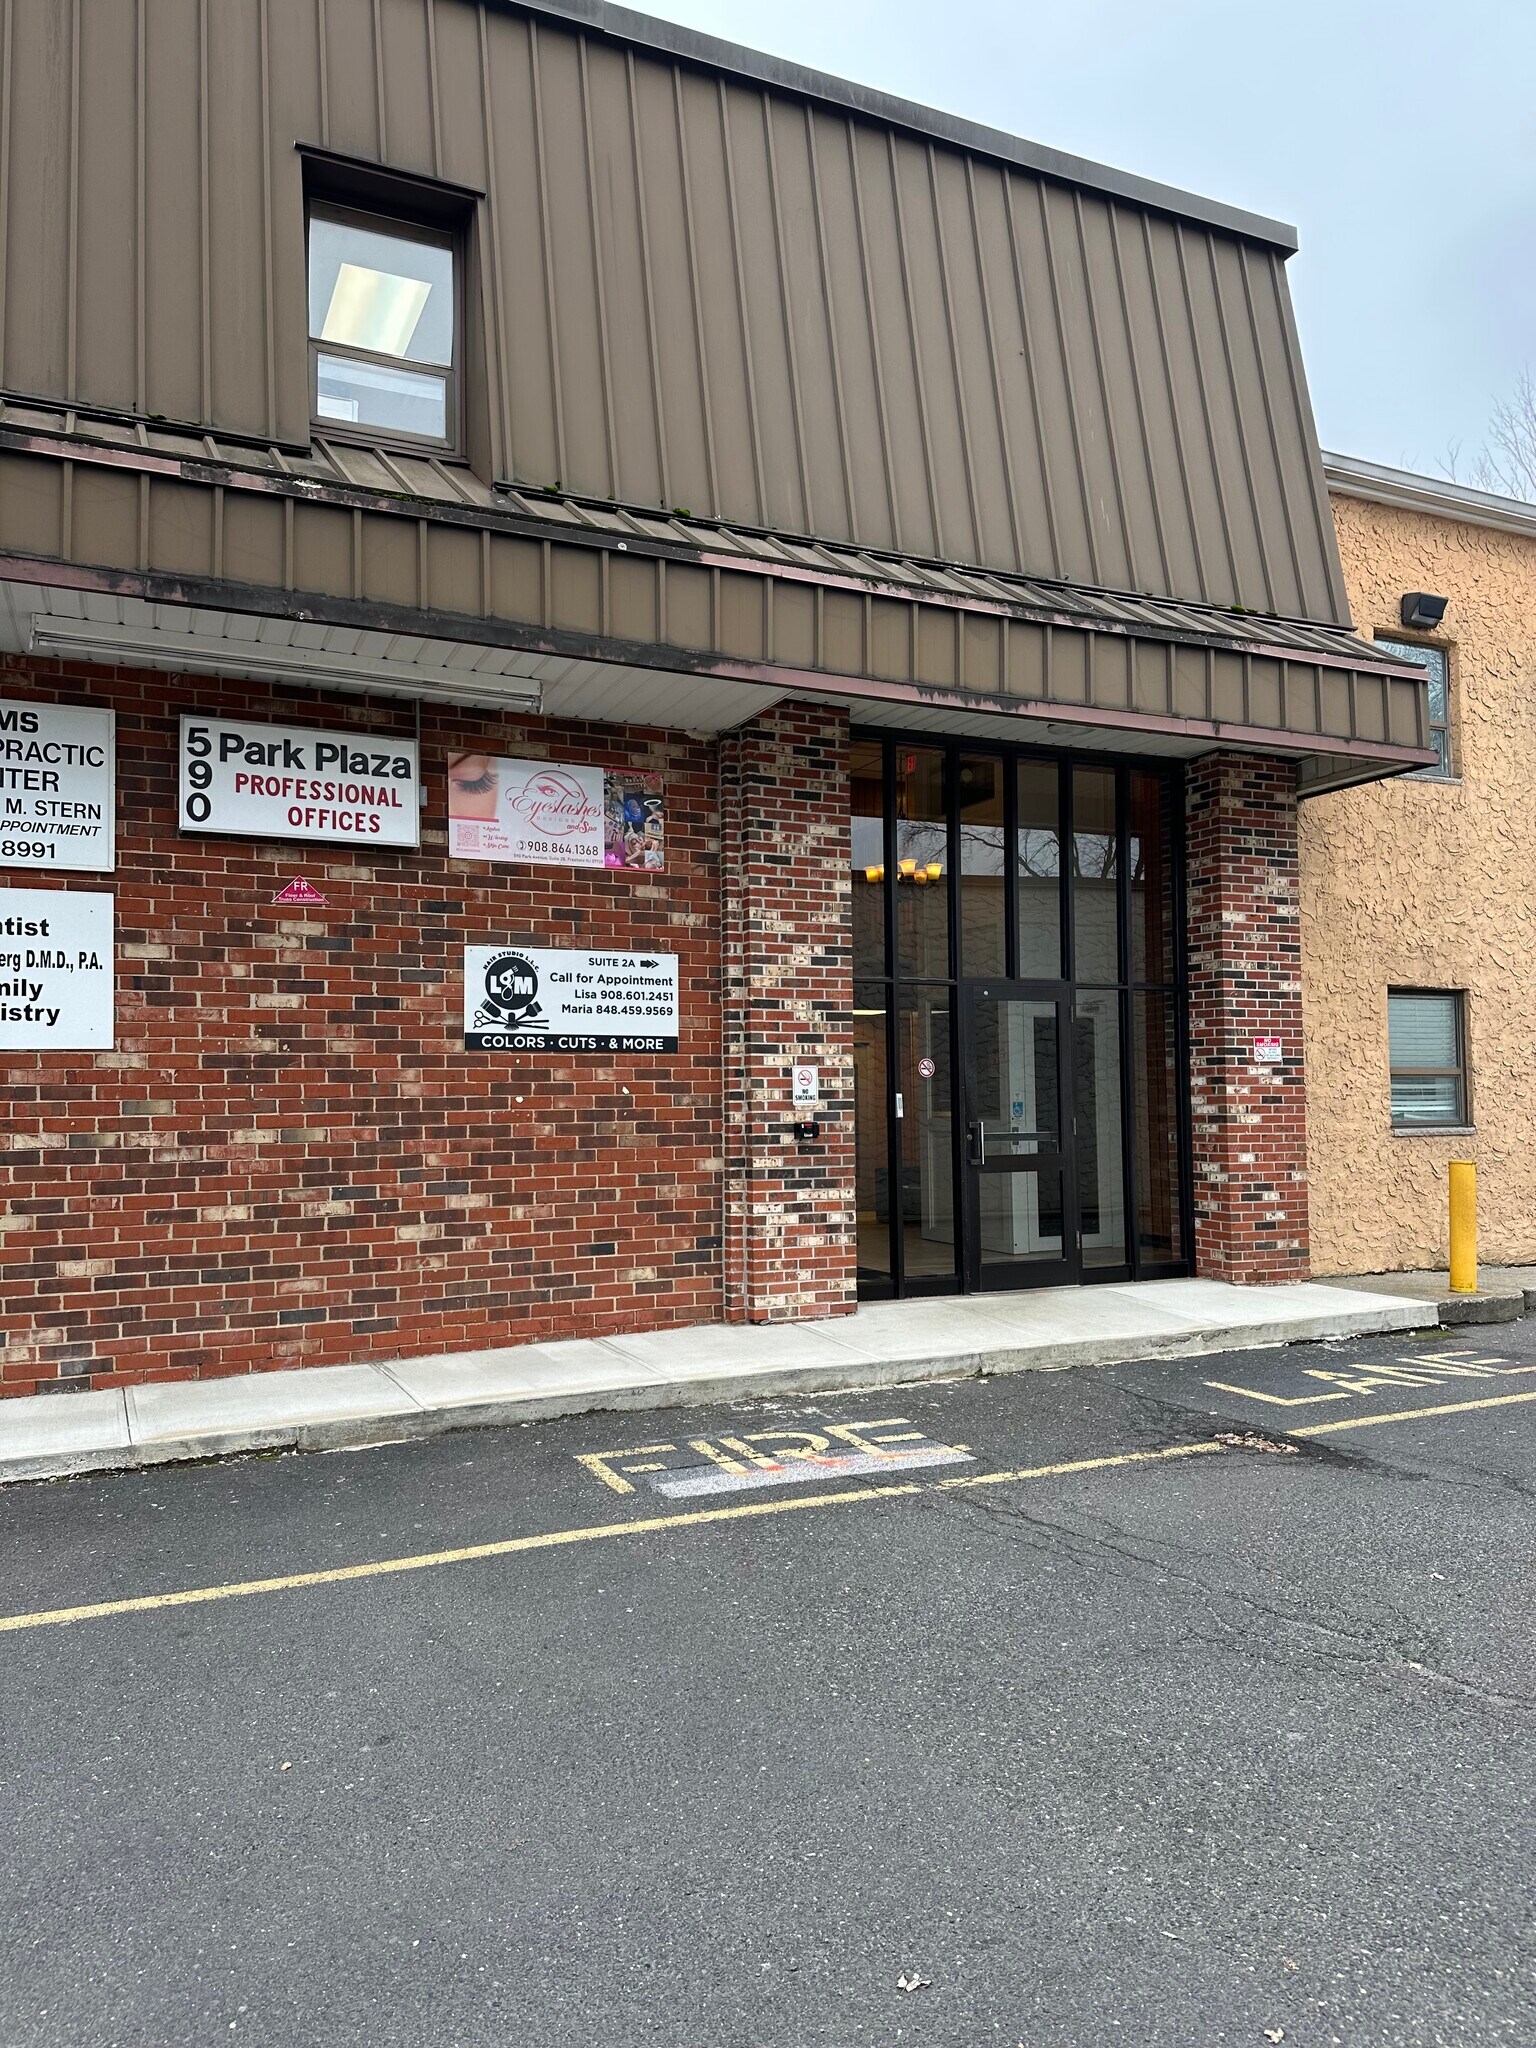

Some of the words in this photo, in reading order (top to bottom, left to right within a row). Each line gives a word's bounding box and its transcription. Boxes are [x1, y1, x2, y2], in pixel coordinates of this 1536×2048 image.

[219, 732, 306, 770] Park
[315, 742, 412, 779] Plaza
[0, 767, 60, 792] TER
[235, 772, 402, 808] PROFESSIONAL
[5, 798, 27, 815] M.
[34, 800, 102, 820] STERN
[288, 806, 381, 833] OFFICES
[0, 820, 102, 837] PPOINTMENT
[579, 821, 598, 834] Spa
[527, 840, 599, 856] 908.864.1368
[294, 881, 309, 891] FR
[26, 949, 74, 973] D.M.D.,
[78, 951, 103, 970] P.A.
[483, 955, 497, 971] HAIR
[498, 950, 524, 958] STUDIO
[588, 957, 619, 967] SUITE
[621, 959, 636, 967] 2A
[550, 972, 573, 983] Call
[576, 973, 594, 983] for
[597, 974, 673, 986] Appointment
[574, 989, 597, 999] Lisa
[600, 990, 674, 1001] 908.601.2451
[1, 1002, 61, 1026] istry
[561, 1004, 593, 1014] Maria
[596, 1005, 673, 1016] 848.459.9569
[481, 1035, 546, 1048] COLORS
[558, 1037, 597, 1049] CUTS
[608, 1038, 618, 1049] &
[622, 1038, 664, 1050] MORE
[1203, 1350, 1536, 1407] LANE
[573, 1417, 972, 1494] FIRE
